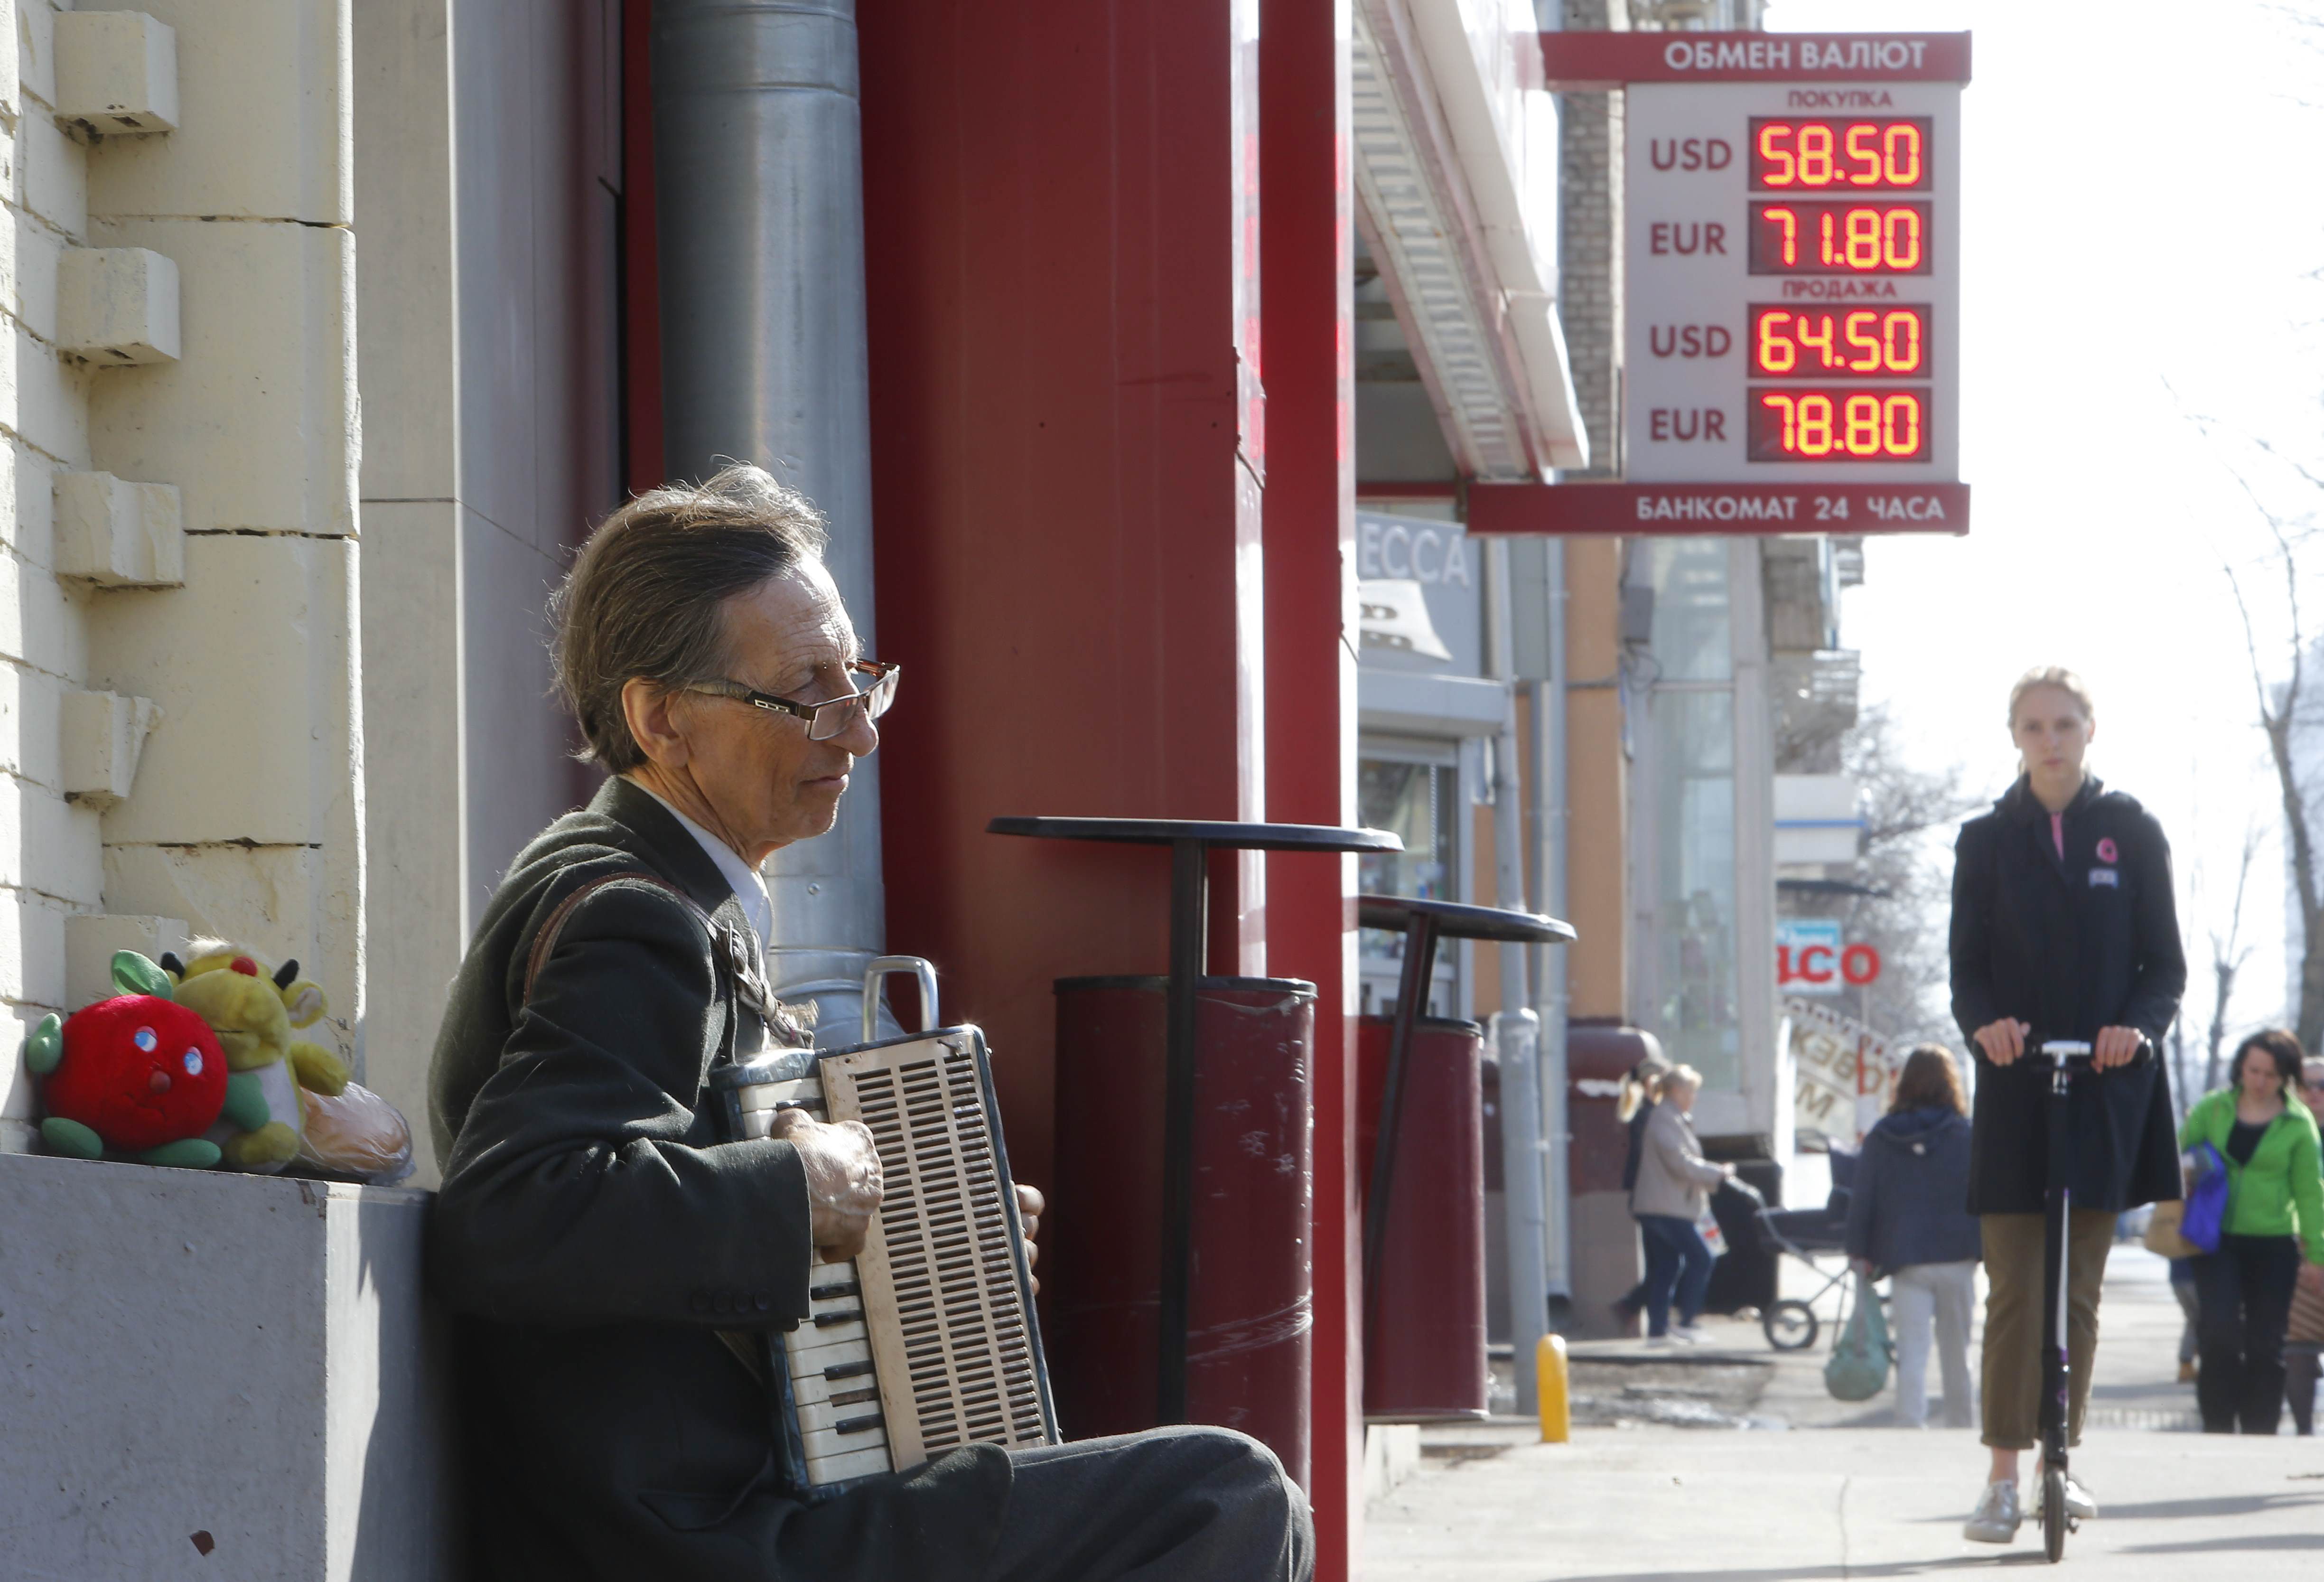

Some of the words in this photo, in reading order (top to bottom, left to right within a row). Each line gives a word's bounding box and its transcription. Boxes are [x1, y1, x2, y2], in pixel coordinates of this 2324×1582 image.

[1664, 41, 1791, 70] ОБМЕН
[1800, 41, 1929, 70] ВАЛЮТ
[1787, 90, 1894, 109] ПОКУПКА
[1650, 138, 1733, 172] USD
[1759, 123, 1921, 186] 58.50
[1649, 222, 1727, 256] EUR
[1762, 207, 1921, 270] 71.80
[1782, 280, 1898, 299] ПРОДАЖА
[1649, 324, 1733, 359] USD
[1758, 310, 1921, 373] 64.50
[1649, 408, 1727, 442] EUR
[1762, 394, 1921, 457] 78.80
[1637, 496, 1797, 520] БАНКОМАТ
[1814, 496, 1849, 520] 24
[1867, 496, 1947, 520] ЧАСА
